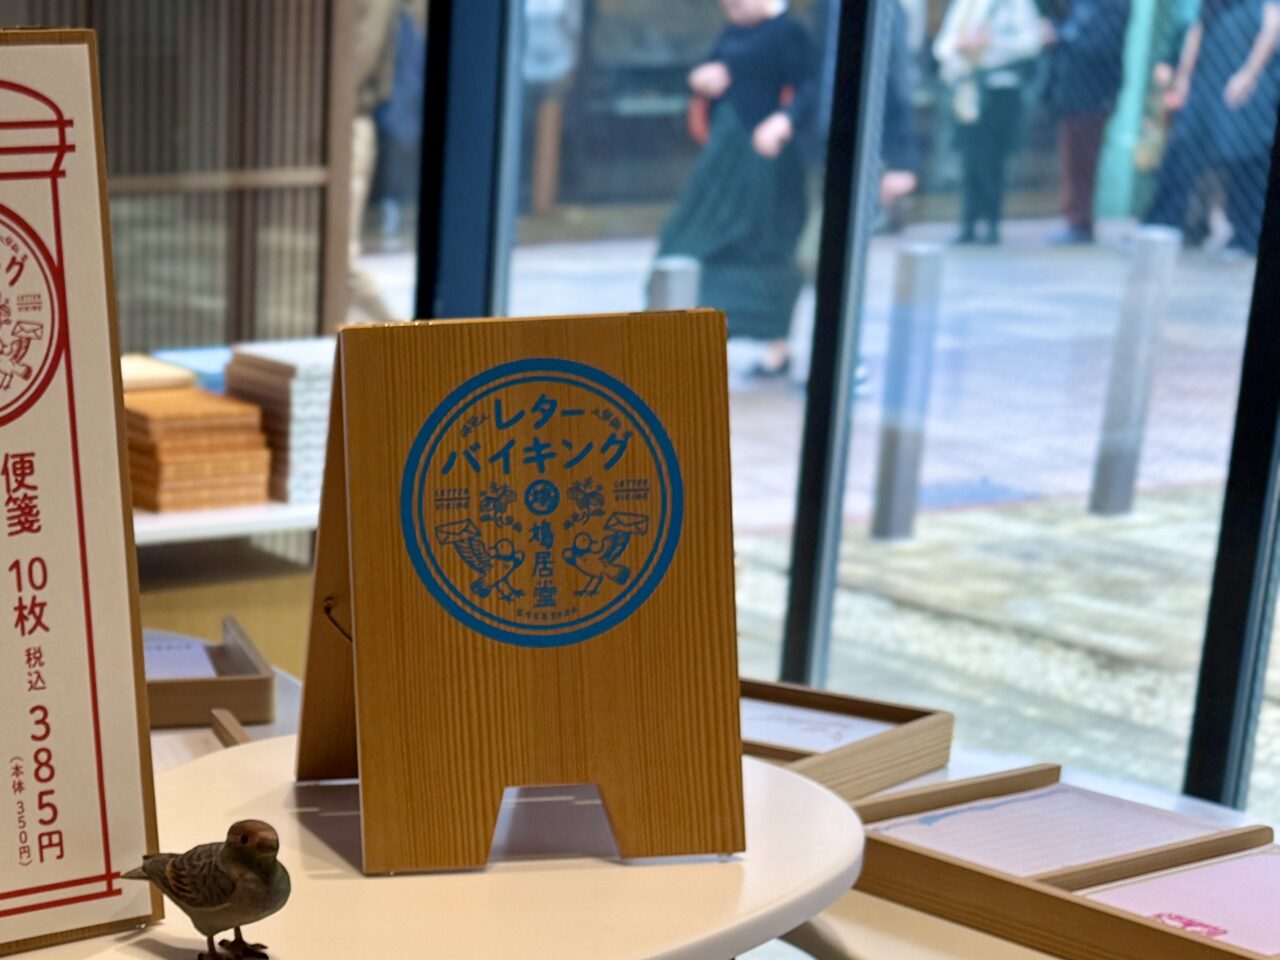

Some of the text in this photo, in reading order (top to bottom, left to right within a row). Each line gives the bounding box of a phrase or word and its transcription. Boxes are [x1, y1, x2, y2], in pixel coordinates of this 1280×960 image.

[494, 393, 586, 430] レター
[441, 431, 634, 475] バイキング
[528, 520, 558, 608] 鳩居堂
[0, 452, 65, 863] 便箋 10枚 税込 385円
